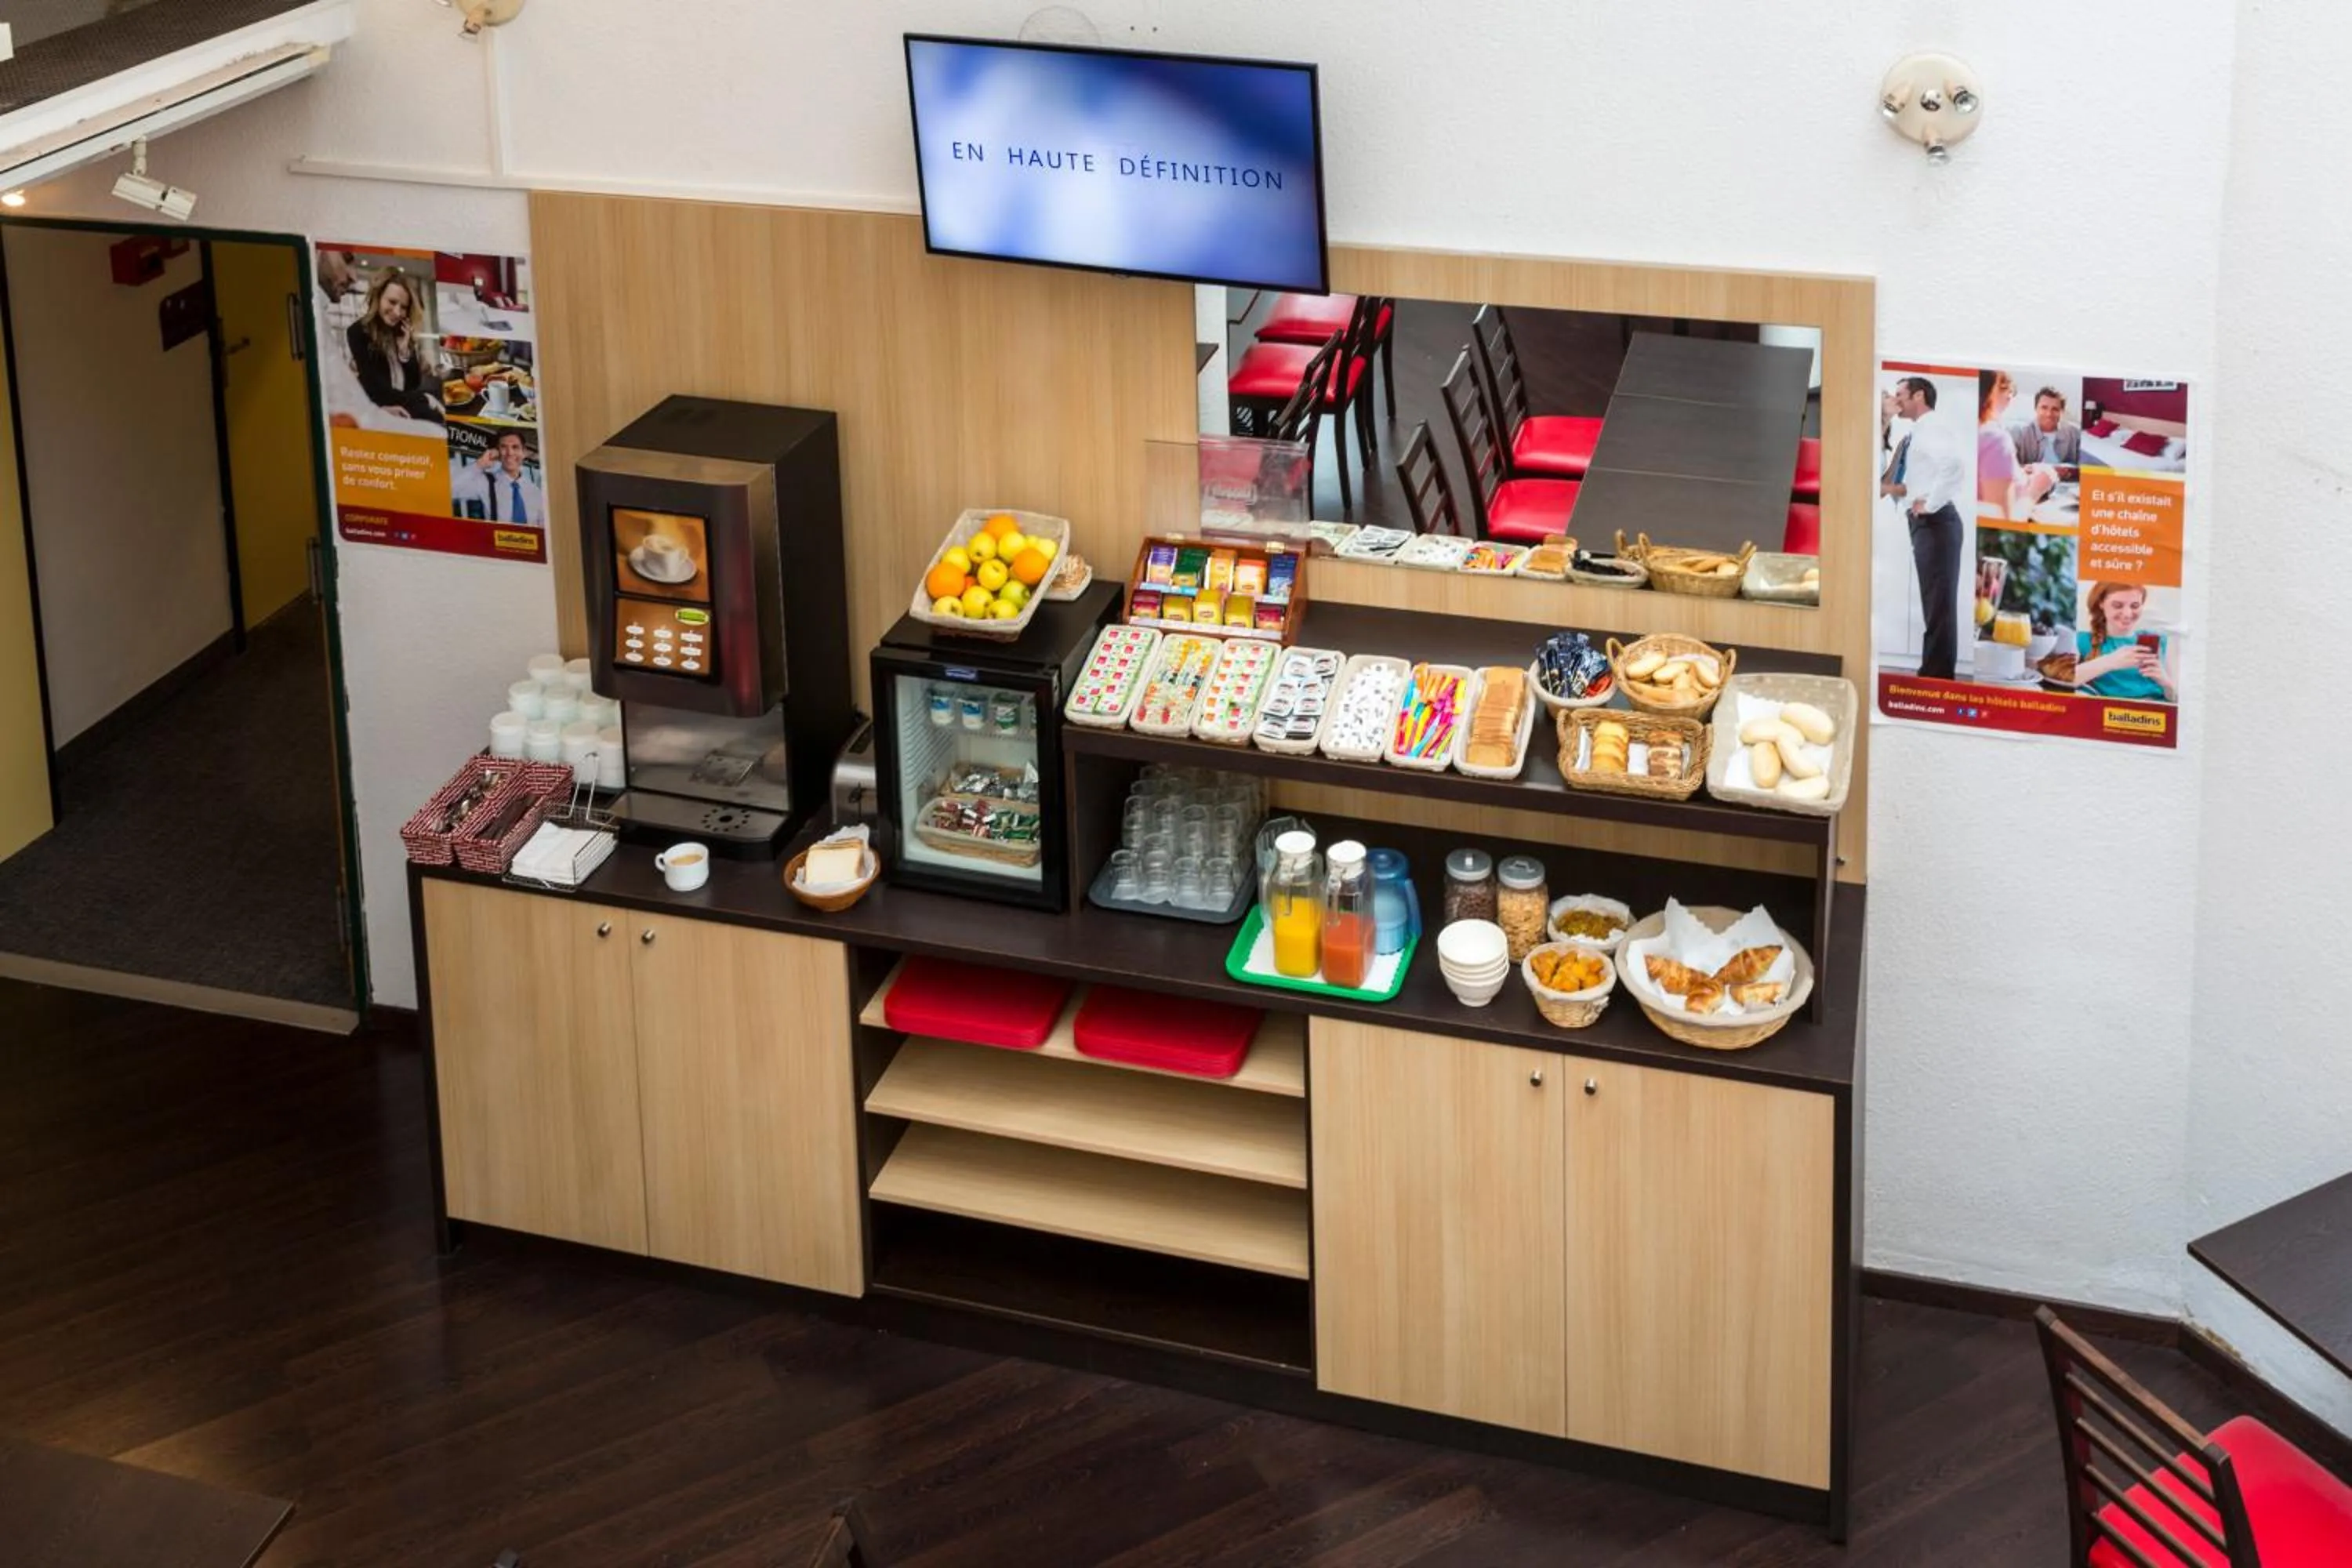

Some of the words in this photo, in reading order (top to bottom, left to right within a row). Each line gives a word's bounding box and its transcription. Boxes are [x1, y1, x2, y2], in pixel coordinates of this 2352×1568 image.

[953, 142, 984, 162] EN
[1007, 147, 1095, 172] HAUTE
[1120, 154, 1283, 191] DÉFINITION
[339, 445, 376, 461] Restez
[342, 462, 366, 474] sans
[368, 465, 393, 476] vous
[394, 468, 426, 480] priver
[343, 474, 356, 485] de
[2091, 488, 2105, 502] Et
[2127, 492, 2172, 507] existait
[2090, 508, 2114, 519] une
[2117, 509, 2158, 522] chaîne
[2090, 522, 2140, 539] d'hôtels
[2089, 543, 2154, 556] accessible
[2089, 557, 2103, 569] et
[2104, 557, 2133, 572] sûre
[2135, 559, 2143, 572] ?
[1888, 683, 1941, 699] Bienvenue
[1943, 690, 1967, 702] dans
[1969, 694, 1984, 705] les
[1986, 695, 2017, 710] hôtels
[1888, 699, 1945, 714] balladins.com
[2108, 710, 2161, 726] balladins
